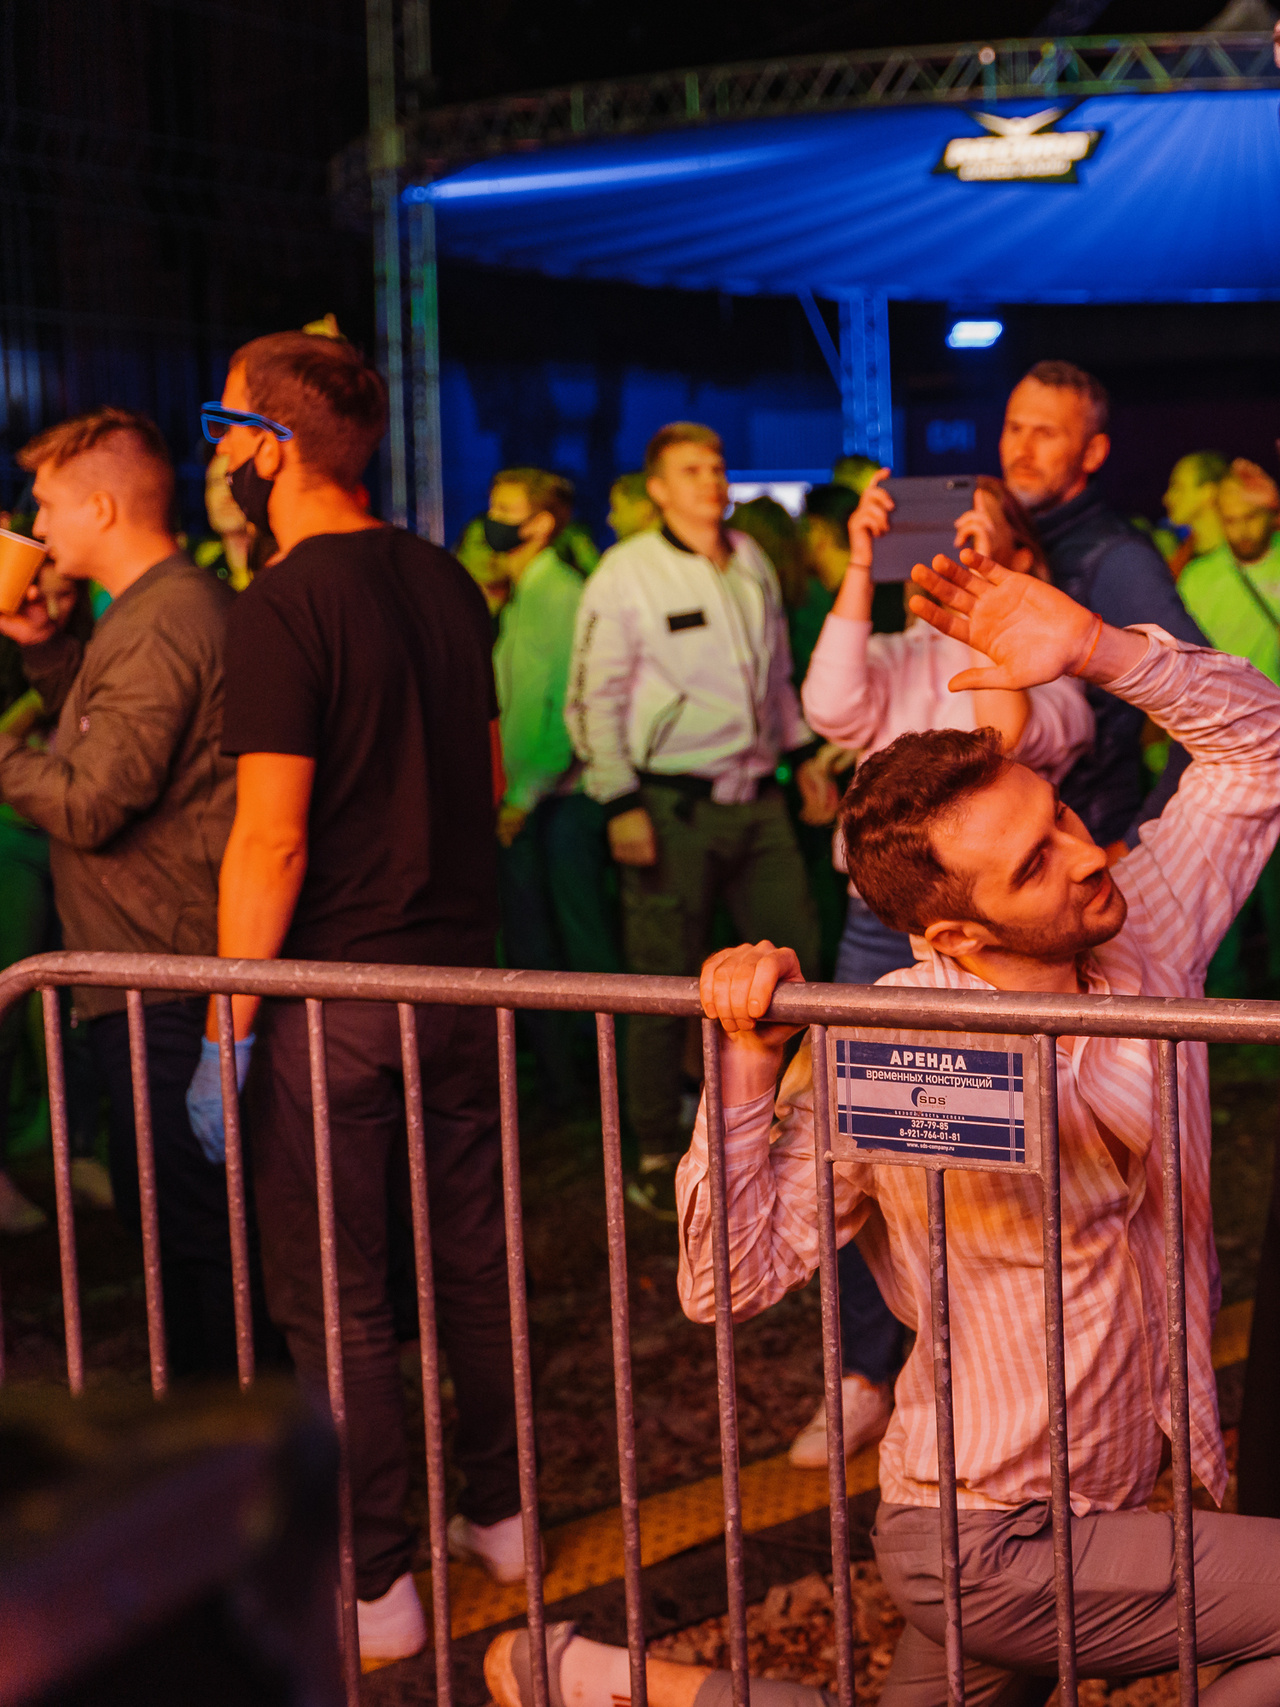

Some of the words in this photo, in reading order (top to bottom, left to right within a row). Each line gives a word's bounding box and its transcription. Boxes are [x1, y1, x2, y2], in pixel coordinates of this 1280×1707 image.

[890, 1050, 967, 1071] АРЕНДА
[866, 1069, 924, 1083] временных
[925, 1073, 993, 1089] конструкций
[919, 1095, 946, 1106] SDS
[911, 1119, 949, 1131] 327-79-85
[899, 1127, 961, 1142] 8-921-764-01-81
